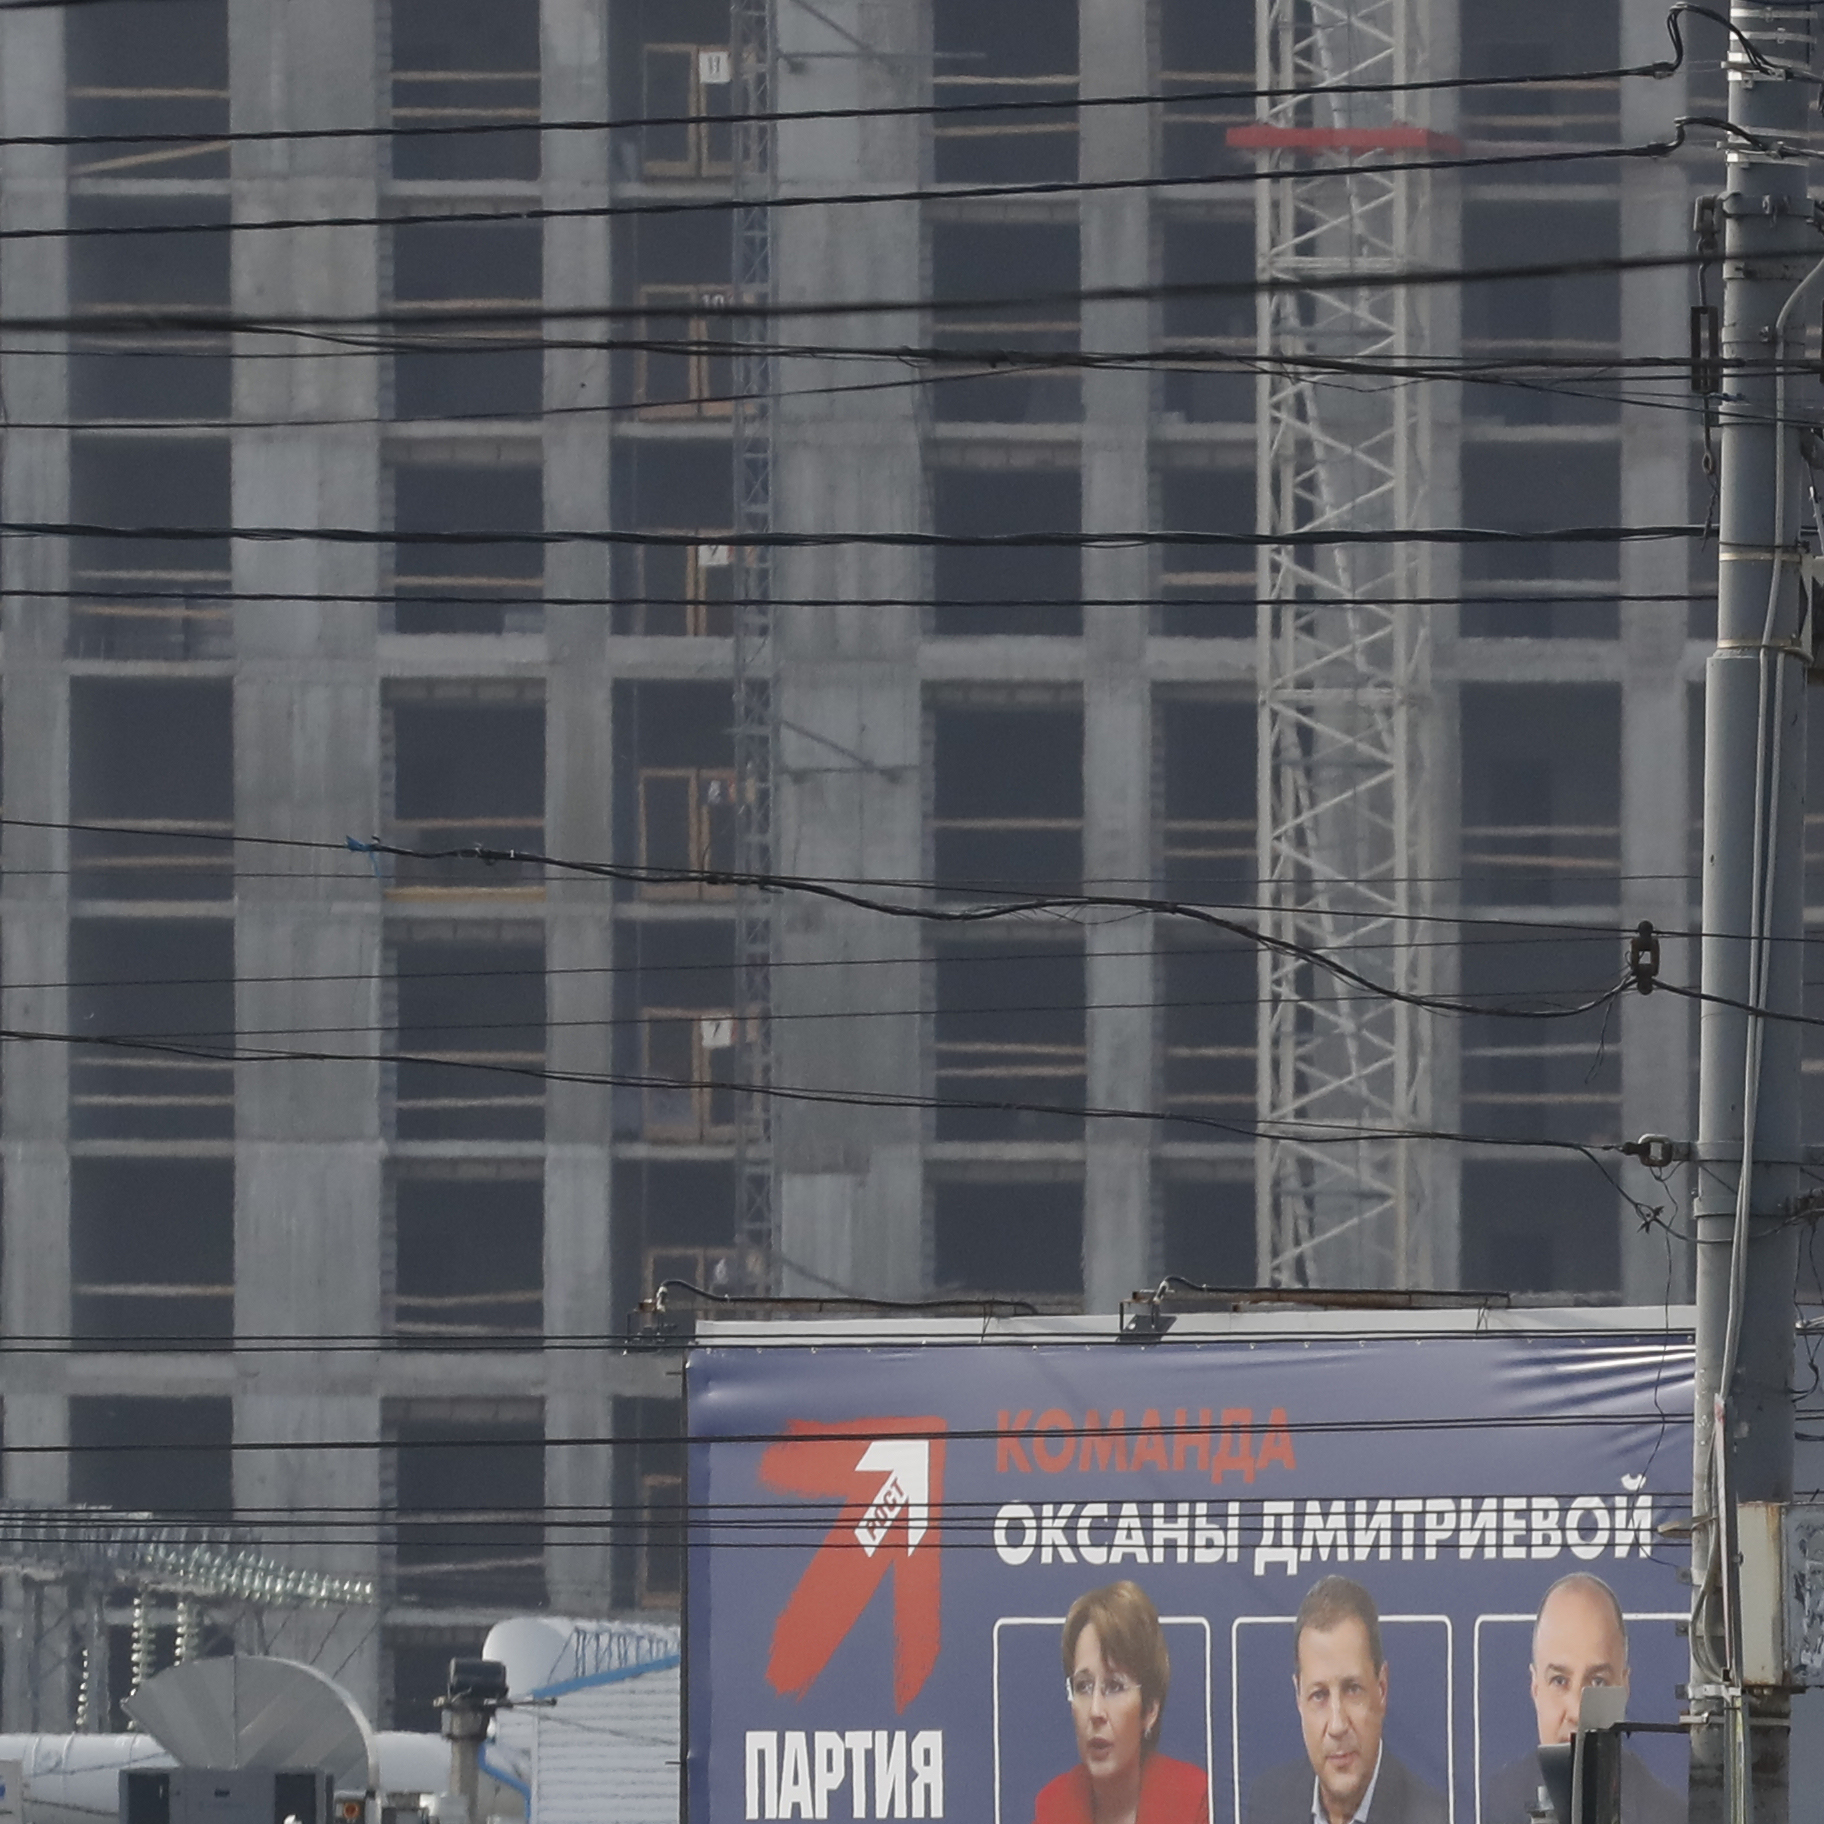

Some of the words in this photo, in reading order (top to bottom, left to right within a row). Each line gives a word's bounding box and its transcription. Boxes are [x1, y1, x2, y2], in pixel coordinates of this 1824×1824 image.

[996, 1407, 1296, 1485] КОМАНДА
[993, 1500, 1239, 1566] ОКСАНЫ
[1253, 1473, 1653, 1577] ДМИТРИЕВОЙ
[745, 1730, 944, 1820] ПАРТИЯ
